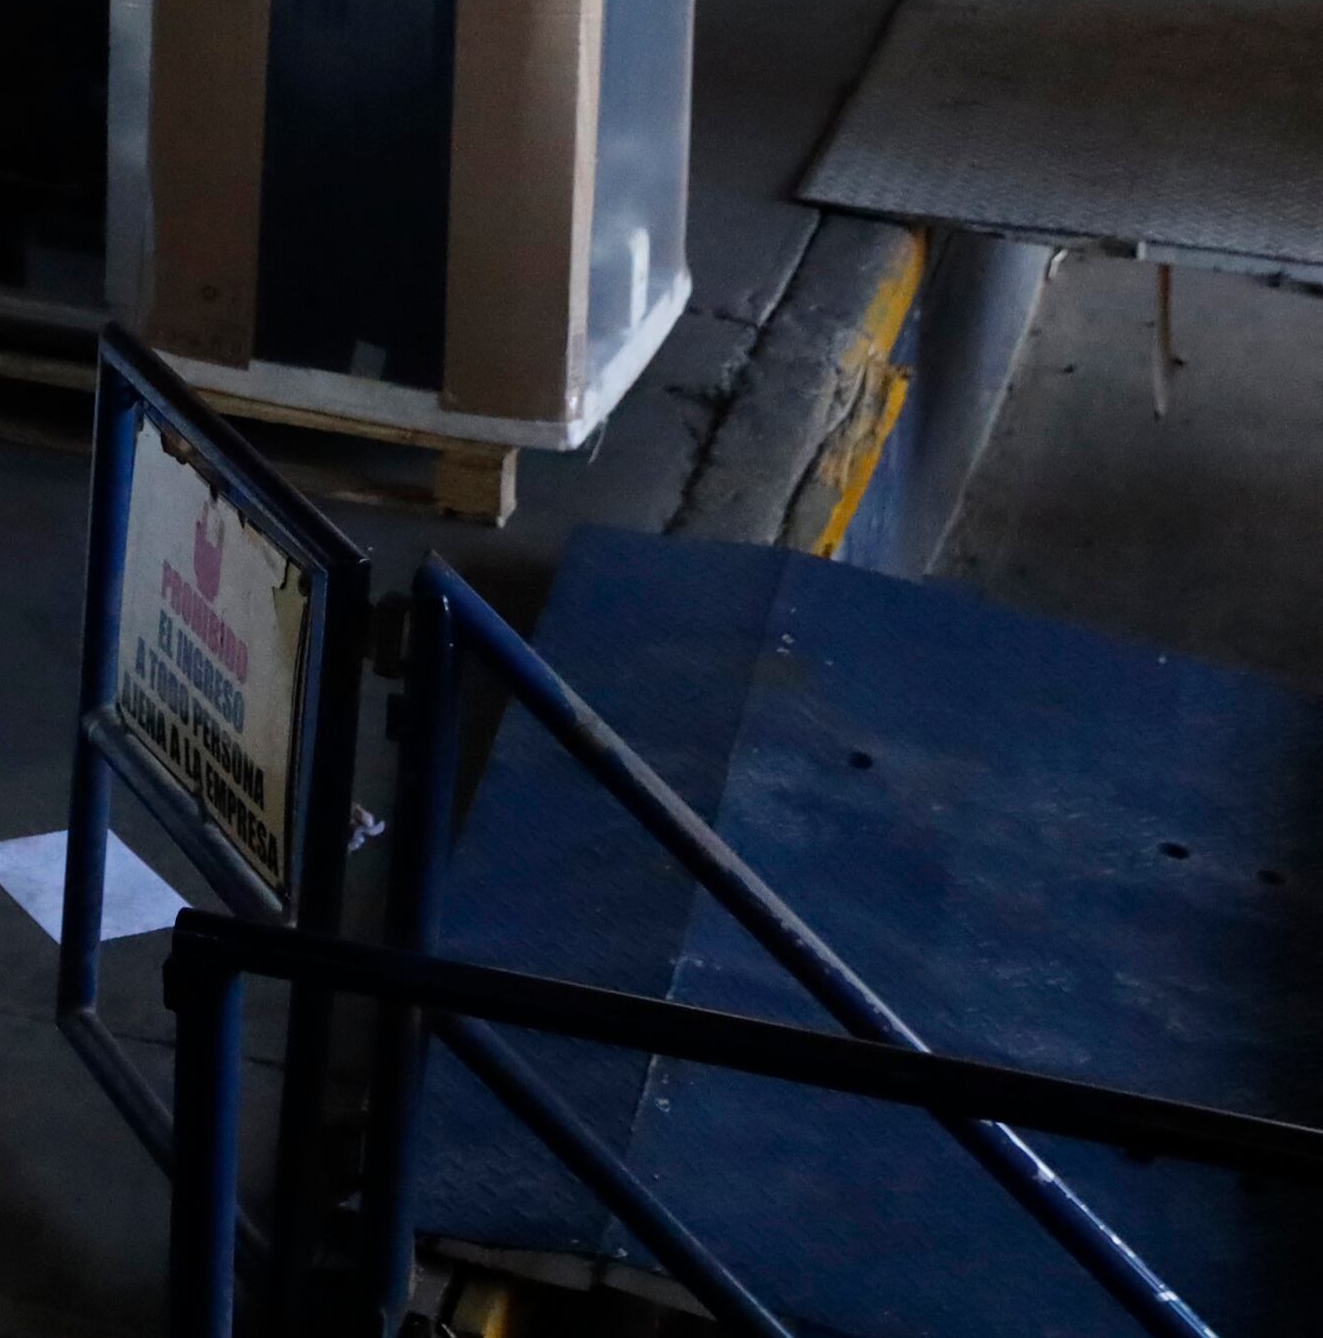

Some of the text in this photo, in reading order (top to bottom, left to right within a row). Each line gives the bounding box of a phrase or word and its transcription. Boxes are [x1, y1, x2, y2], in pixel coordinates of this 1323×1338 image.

[157, 608, 245, 735] EL INGRESO
[161, 558, 249, 687] PROHIBIDO
[121, 670, 167, 753] AJENA
[184, 736, 203, 792] LA
[205, 760, 280, 877] EMPRESA
[135, 635, 266, 812] A TODO PERSONA
